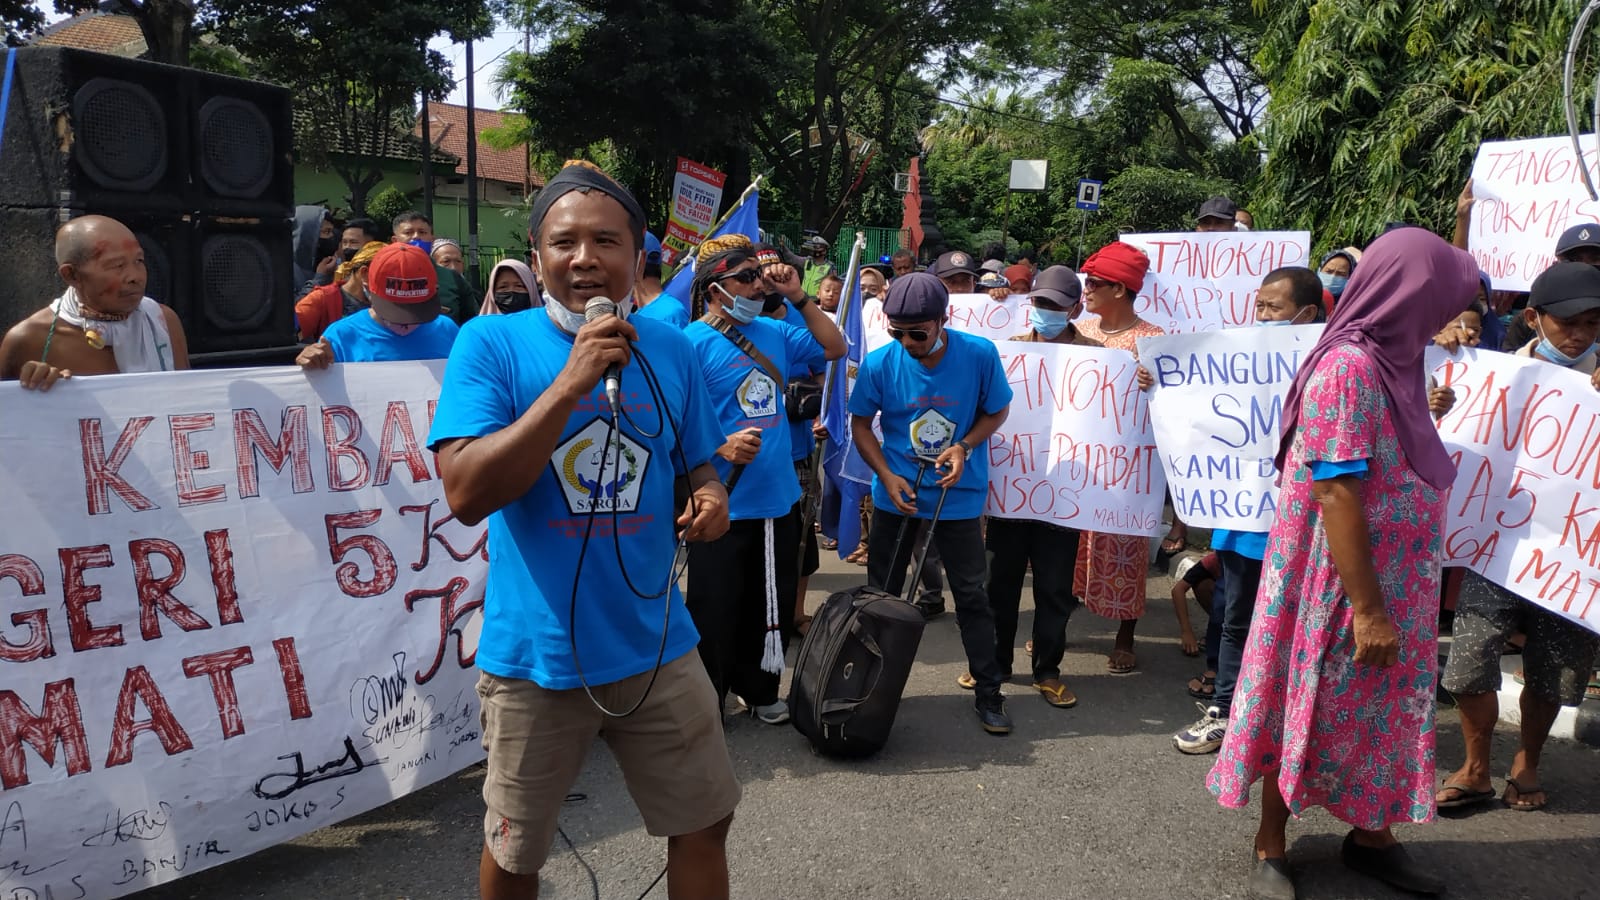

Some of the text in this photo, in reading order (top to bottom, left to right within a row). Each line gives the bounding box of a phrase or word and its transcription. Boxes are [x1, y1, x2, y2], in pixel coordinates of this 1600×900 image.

[1487, 146, 1600, 188] TANGK
[694, 193, 715, 207] FITRI
[1147, 239, 1303, 279] TANGKAP
[1000, 353, 1151, 435] ANGKA
[1168, 453, 1241, 481] KAMI
[576, 498, 631, 511] SAROJA
[1174, 484, 1277, 520] HARGA
[1495, 465, 1550, 529] 5
[1093, 505, 1158, 530] MALING
[325, 508, 398, 599] 5
[0, 636, 313, 791] MATI
